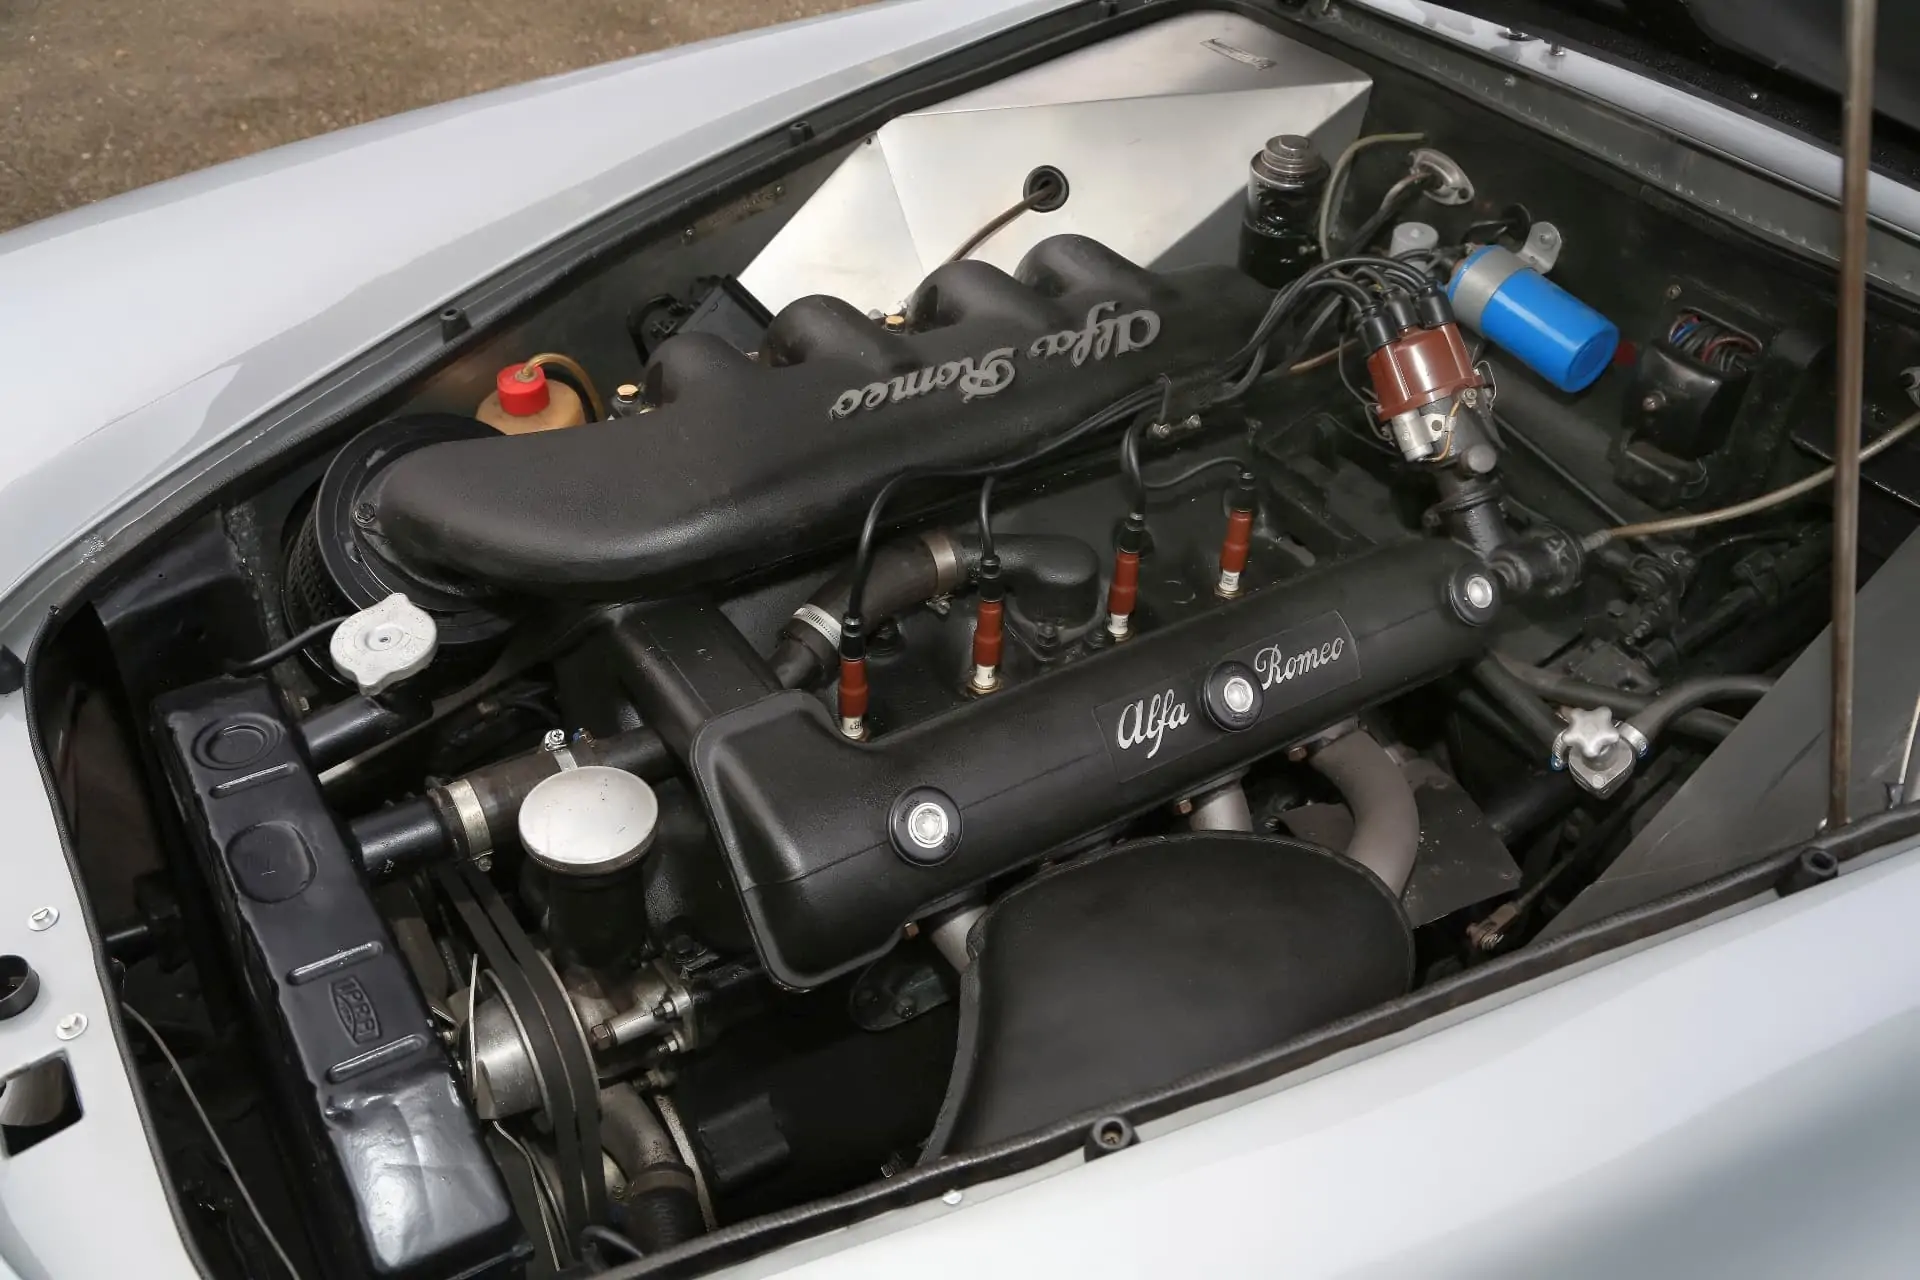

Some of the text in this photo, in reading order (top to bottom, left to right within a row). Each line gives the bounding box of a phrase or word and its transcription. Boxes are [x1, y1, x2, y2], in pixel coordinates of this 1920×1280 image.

[829, 300, 1161, 420] Alfa Romeo
[1117, 637, 1345, 758] Alfa Romeo
